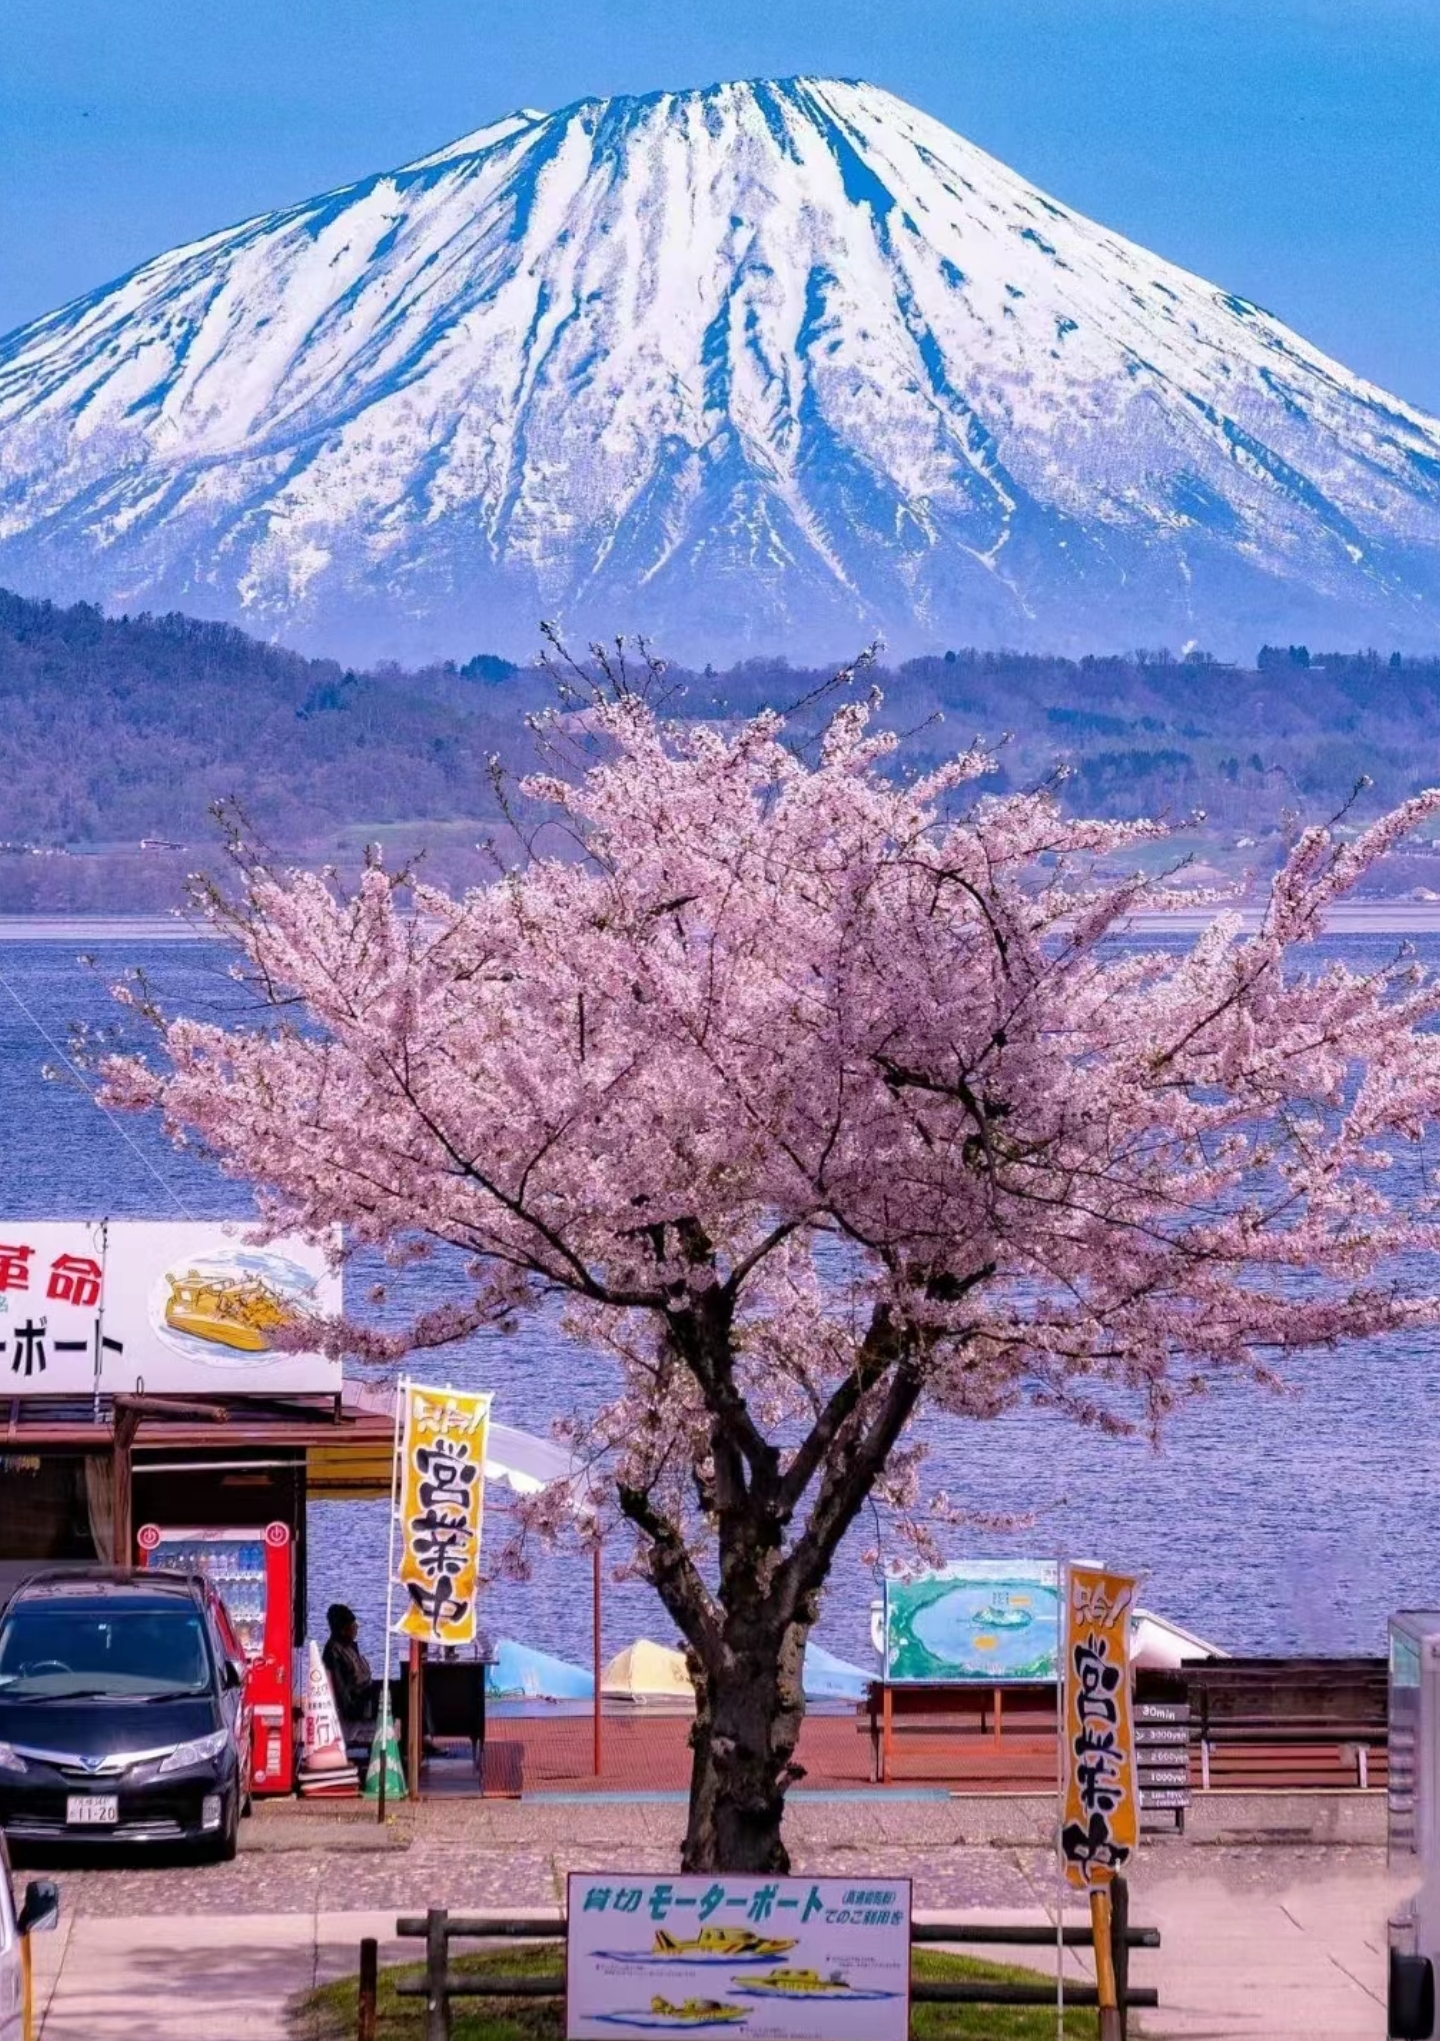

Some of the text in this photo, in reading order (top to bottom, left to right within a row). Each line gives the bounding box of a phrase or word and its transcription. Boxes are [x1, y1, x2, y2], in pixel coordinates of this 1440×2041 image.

[0, 1316, 123, 1377] ボート
[407, 1439, 477, 1638] 営業中
[1062, 1631, 1130, 1883] 営業中
[1142, 1705, 1176, 1721] 30min
